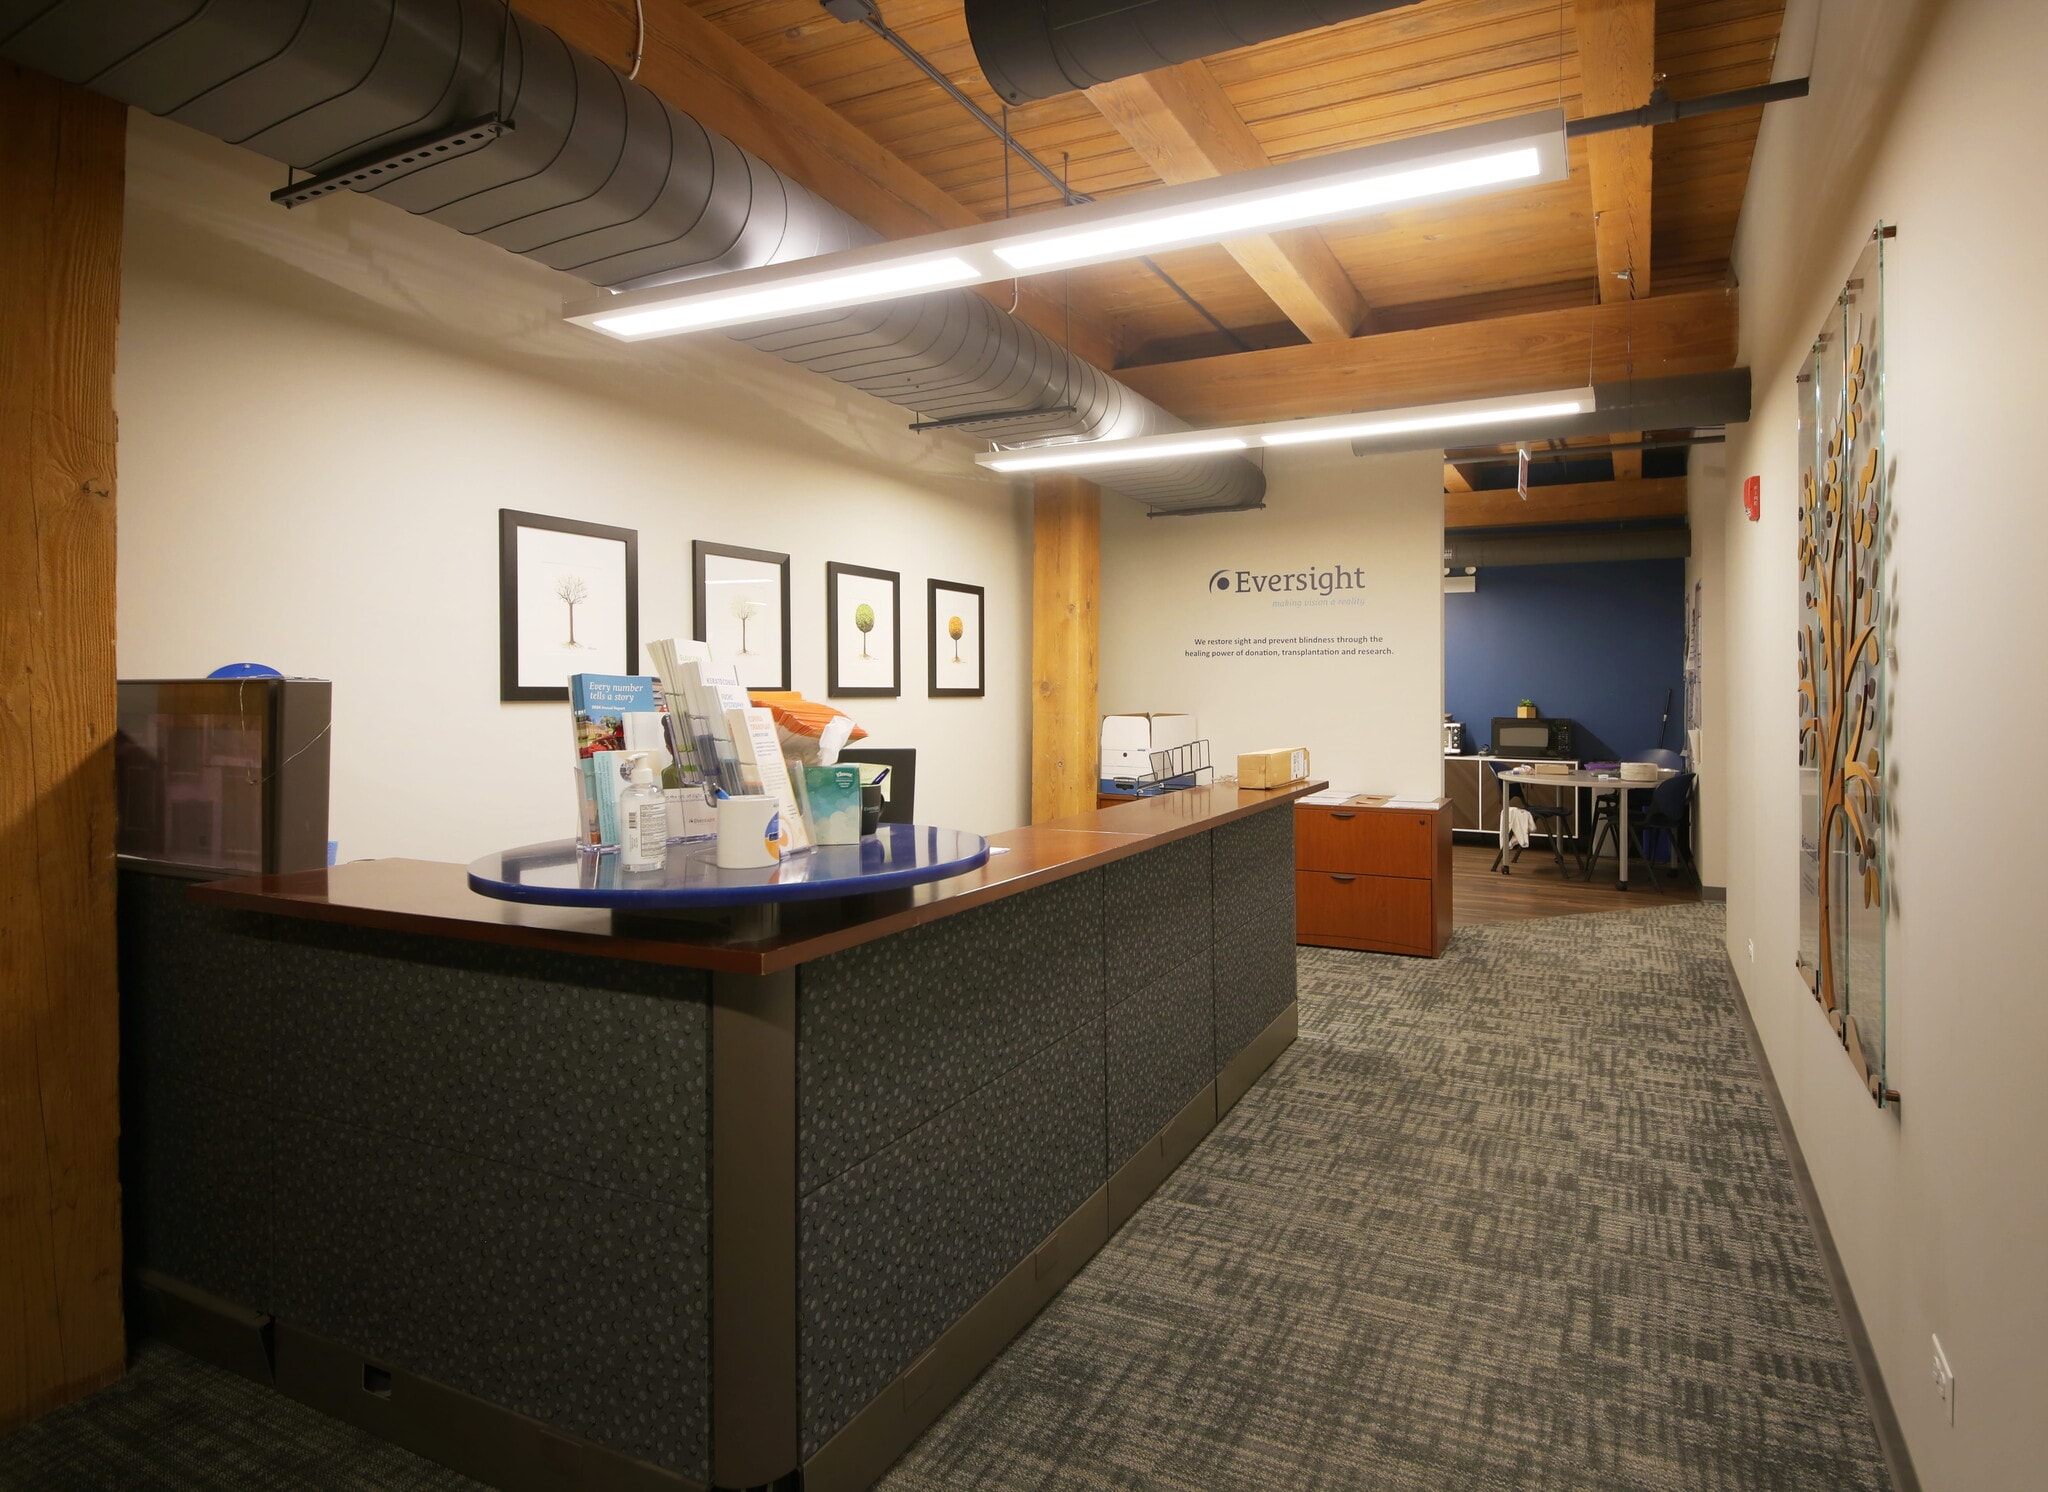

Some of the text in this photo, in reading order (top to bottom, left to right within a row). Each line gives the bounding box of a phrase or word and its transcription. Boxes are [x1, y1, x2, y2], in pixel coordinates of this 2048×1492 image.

[1235, 565, 1366, 596] Eversight
[1272, 599, 1302, 608] making
[1303, 598, 1328, 606] vision
[1337, 598, 1366, 607] reality
[1234, 638, 1252, 646] sight
[1337, 636, 1368, 644] through
[1184, 650, 1211, 658] healing
[1244, 649, 1281, 657] donation,
[1281, 648, 1340, 656] transplantation
[589, 682, 644, 692] Every number
[590, 692, 606, 700] tells
[614, 694, 635, 703] story
